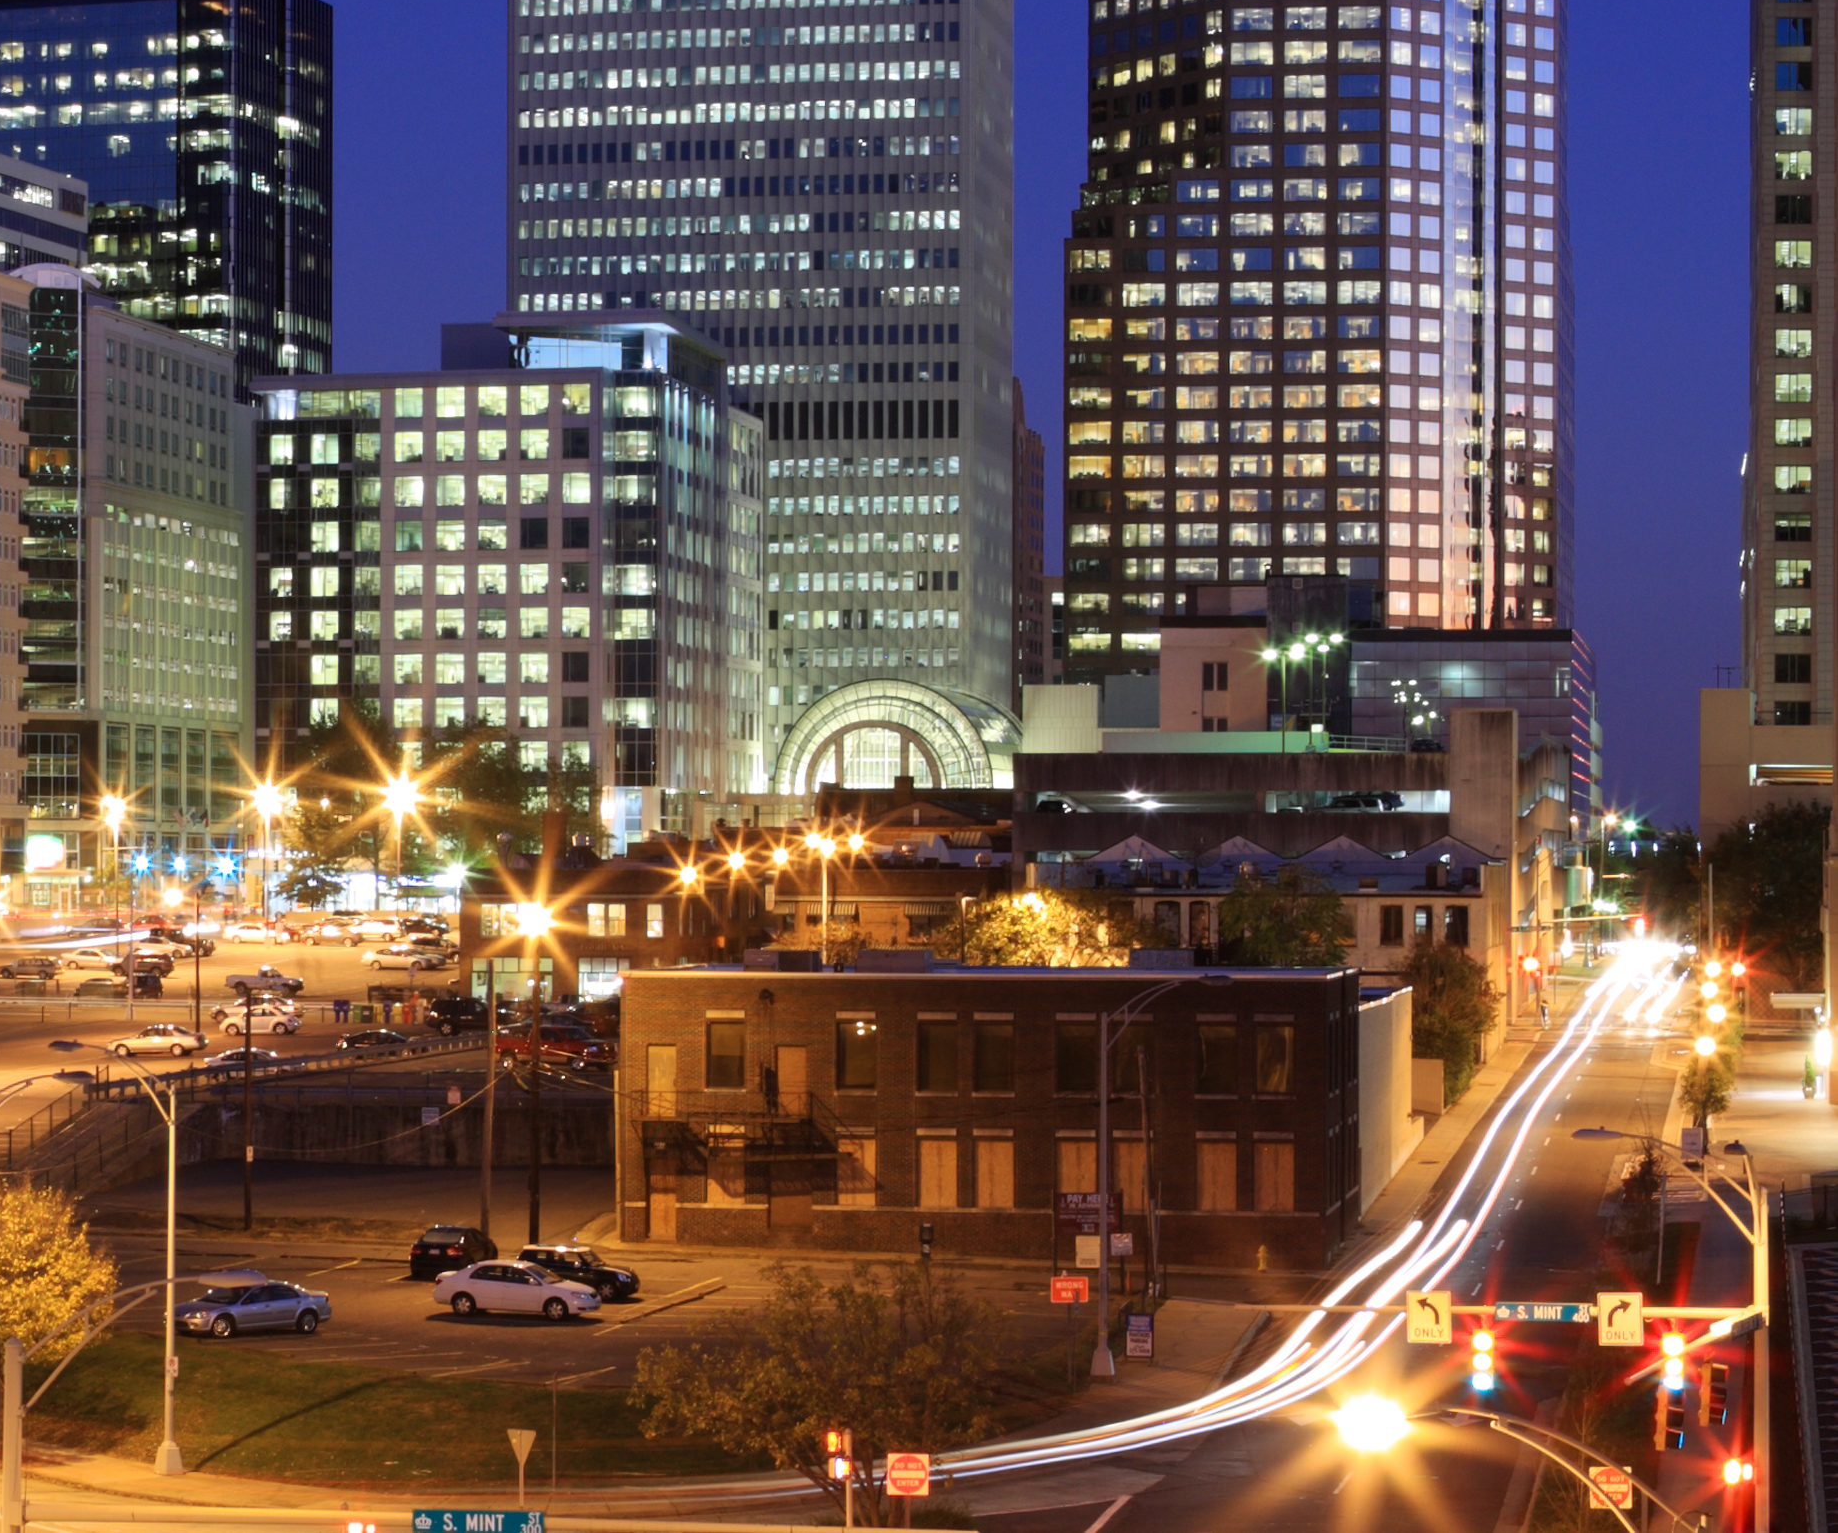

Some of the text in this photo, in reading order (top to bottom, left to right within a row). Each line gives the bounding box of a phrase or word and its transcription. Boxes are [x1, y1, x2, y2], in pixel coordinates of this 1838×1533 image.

[1066, 1194, 1084, 1203] PAY
[1056, 1281, 1084, 1289] WRONG
[1517, 1305, 1588, 1320] S. MINT ST
[1572, 1312, 1589, 1322] 400
[1414, 1328, 1444, 1339] ONLY
[1606, 1330, 1637, 1341] ONLY
[896, 1479, 919, 1487] ENTER
[443, 1512, 541, 1532] S. MINT ST
